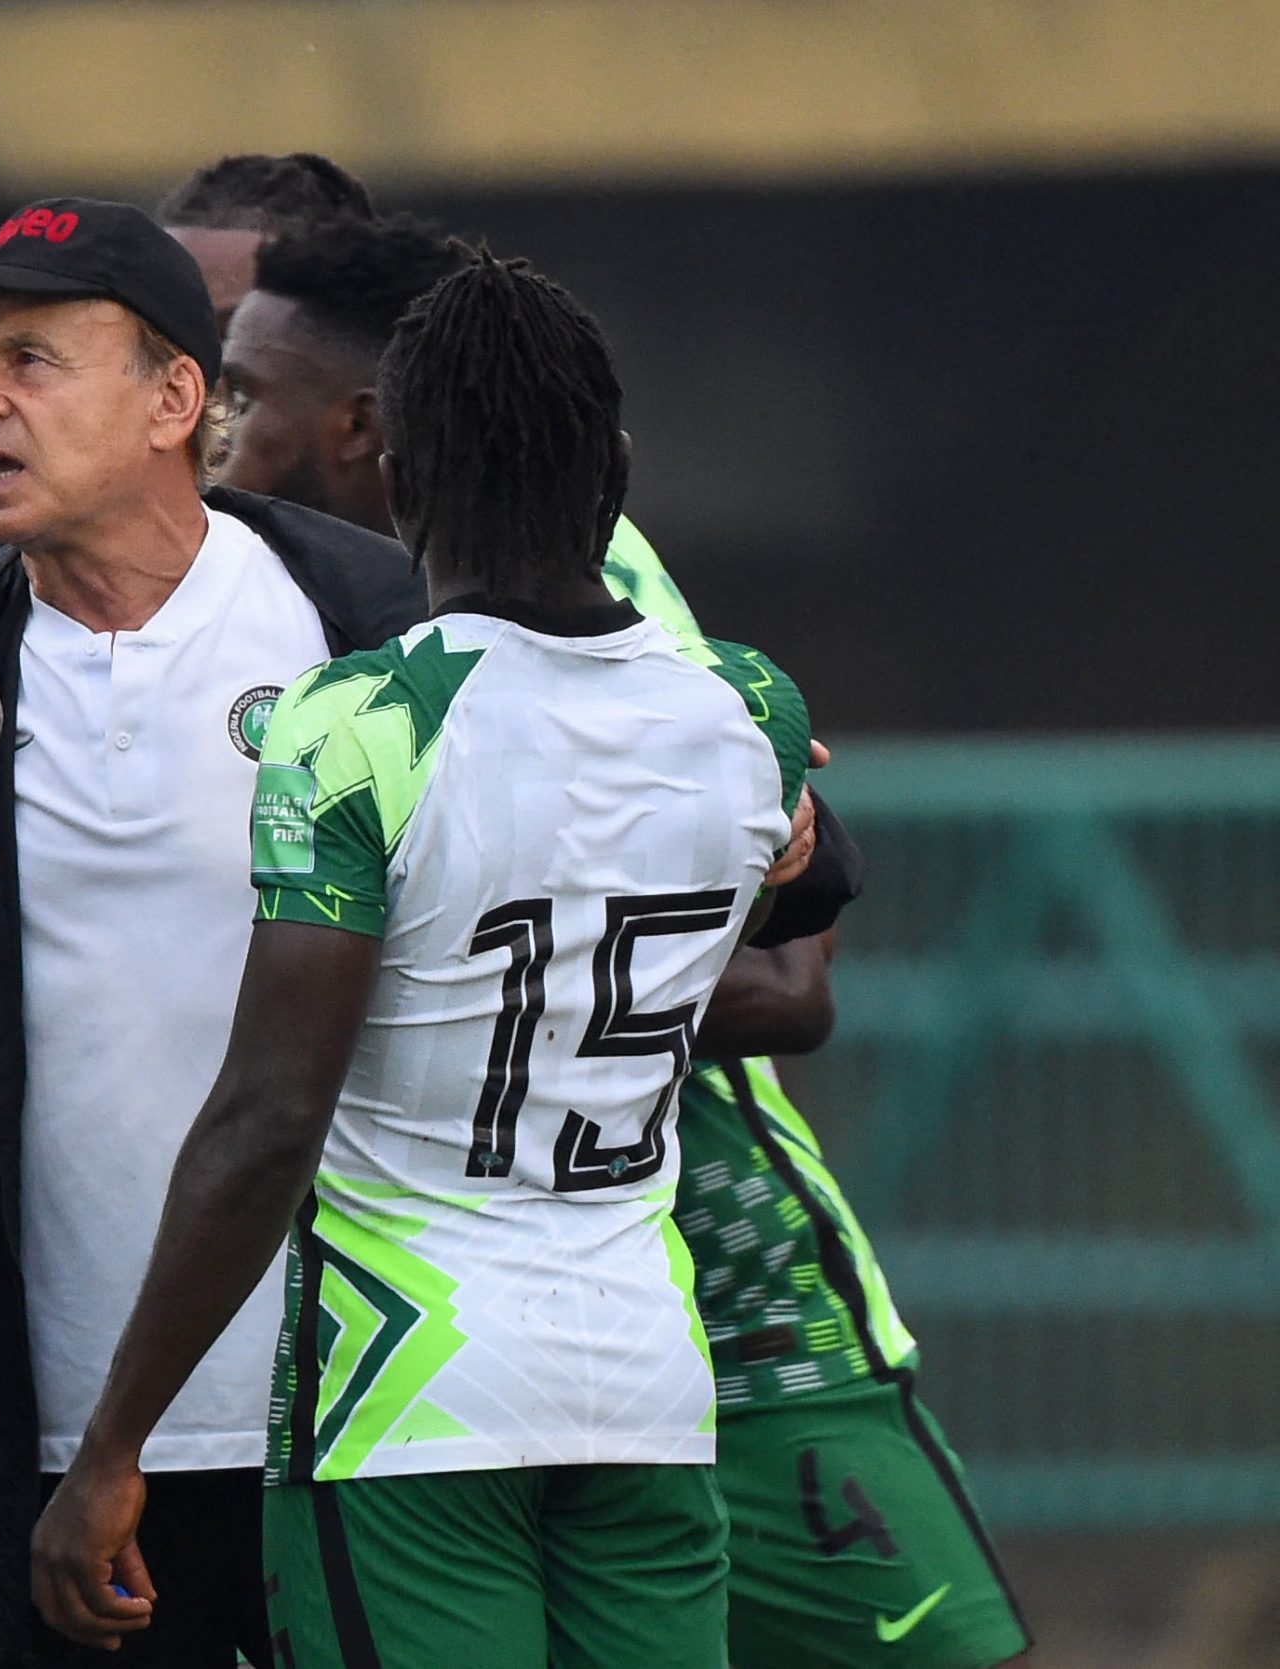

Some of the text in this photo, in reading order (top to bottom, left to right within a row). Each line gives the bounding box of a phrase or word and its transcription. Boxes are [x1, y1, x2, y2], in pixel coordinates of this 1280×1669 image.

[230, 713, 248, 753] NIGERIA
[272, 828, 305, 843] FIFA
[465, 887, 738, 1193] 15
[796, 1446, 900, 1560] 4
